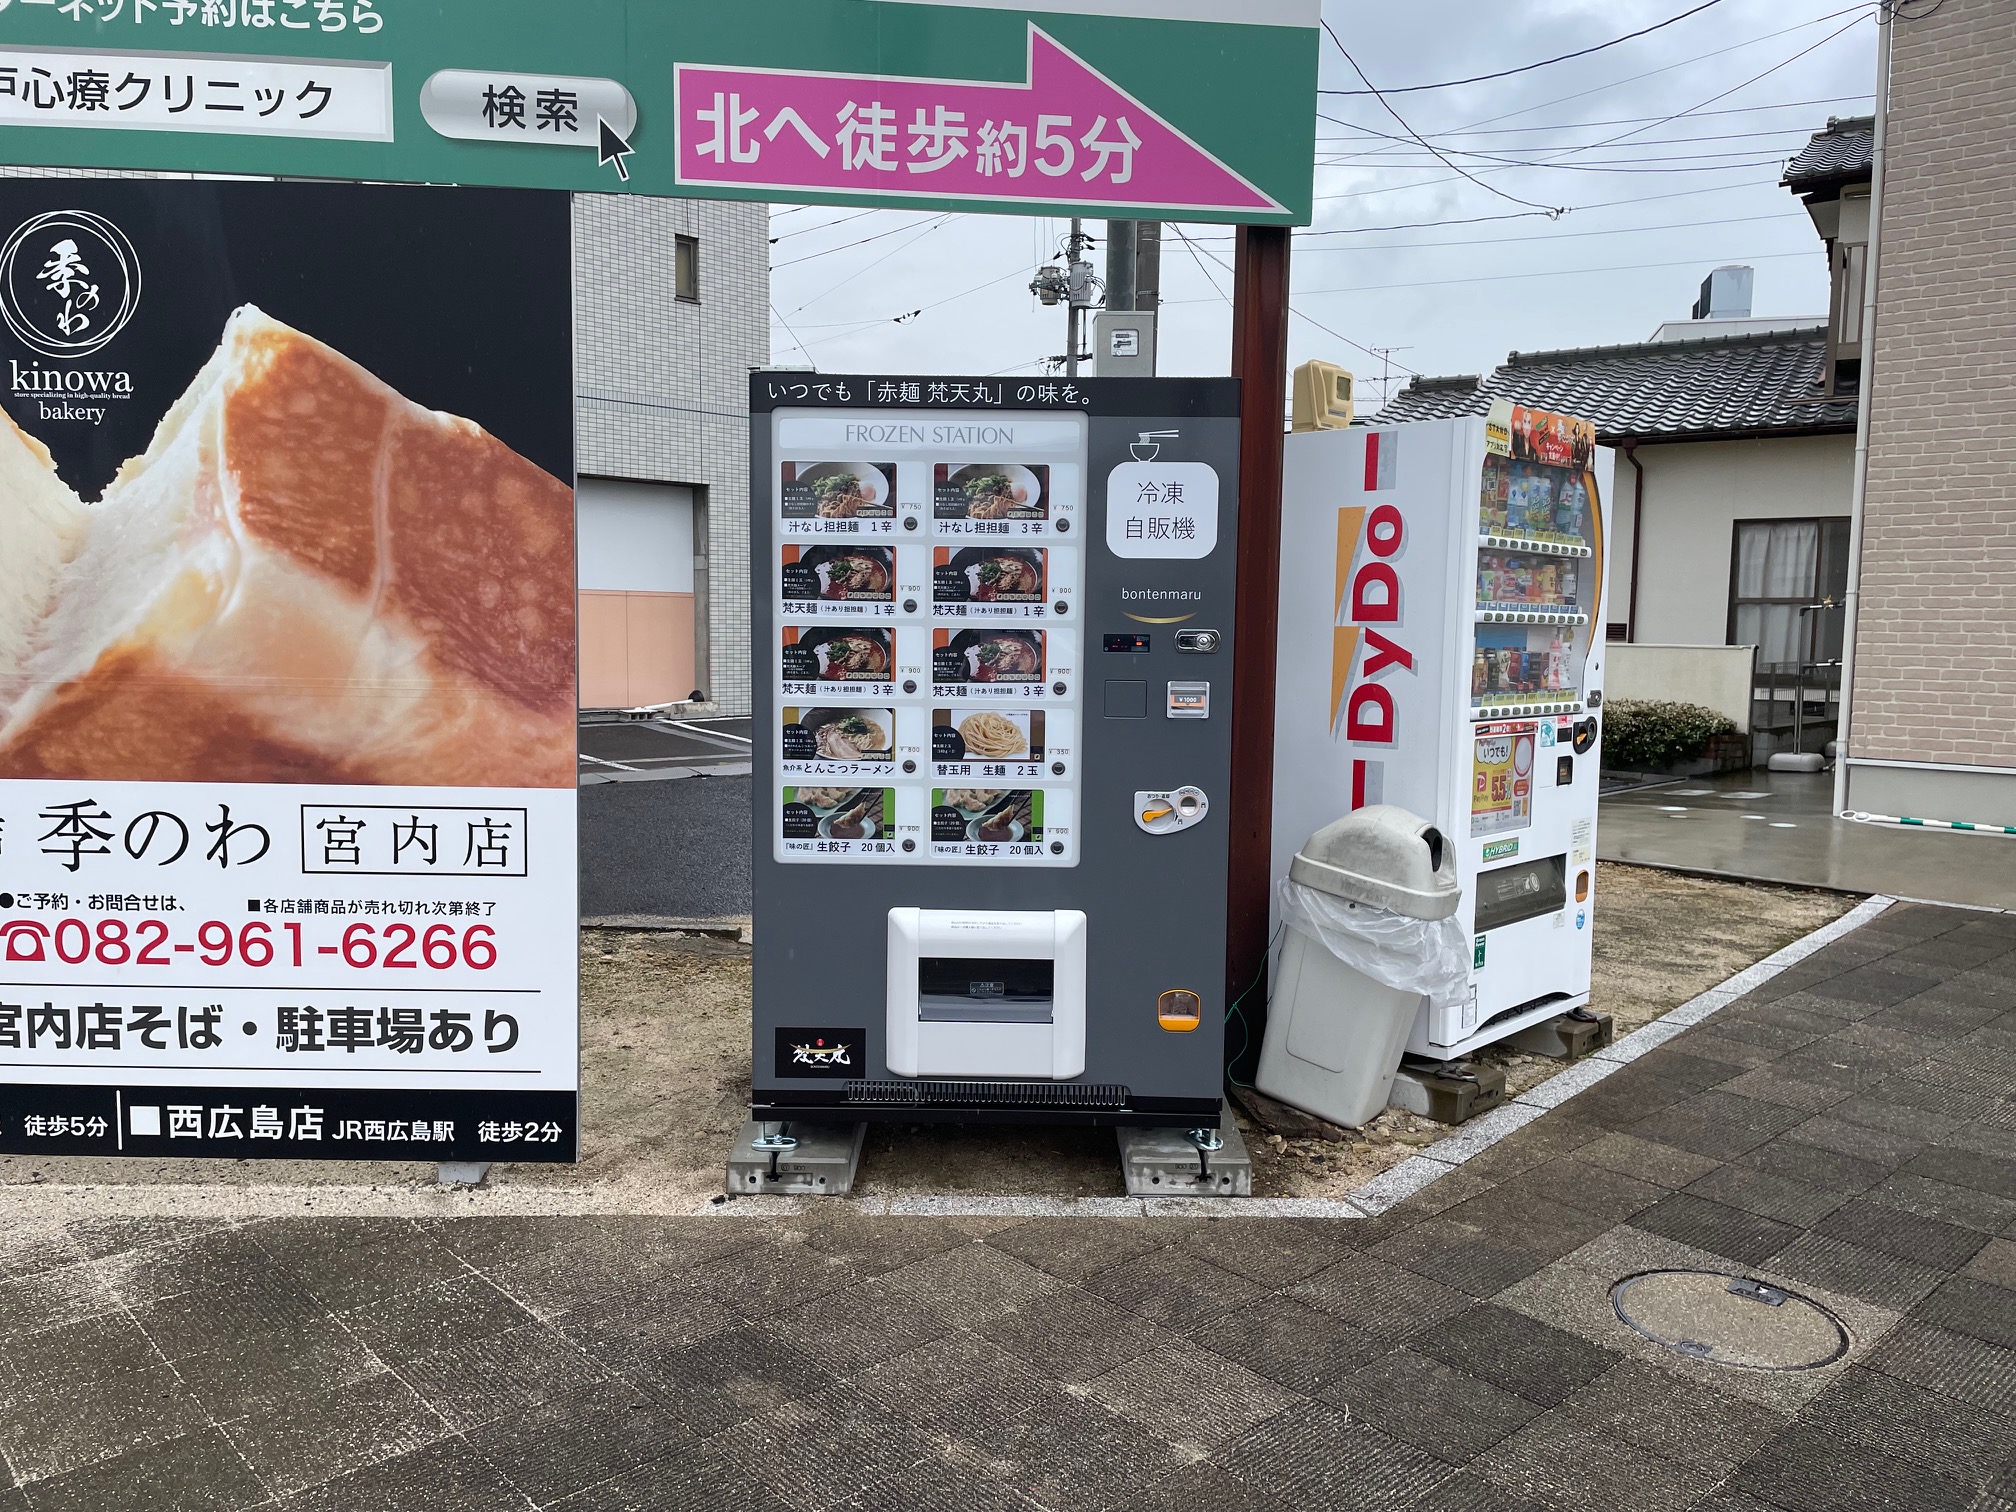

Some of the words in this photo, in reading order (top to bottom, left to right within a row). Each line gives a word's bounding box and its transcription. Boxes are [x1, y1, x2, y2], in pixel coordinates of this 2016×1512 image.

[0, 0, 383, 34] ーネット予約はこちら
[481, 84, 579, 133] 検索
[694, 92, 1143, 185] 北へ徒歩約5分
[9, 360, 134, 393] kinowa
[38, 401, 106, 426] bakery
[845, 425, 924, 444] FROZEN
[933, 426, 1014, 445] STATION
[1136, 481, 1184, 505] 冷凍
[789, 521, 859, 532] 汁なし担担麺
[939, 522, 1009, 533] 汁なし担担麺
[1125, 516, 1196, 541] 自販機
[1121, 587, 1202, 600] bontenmaru
[1346, 504, 1413, 743] DyDo
[937, 765, 970, 776] 替玉用
[983, 765, 1005, 776] 生麺
[37, 798, 271, 872] 季のわ
[316, 814, 514, 868] 宮内店
[1490, 843, 1513, 855] HYBRID
[54, 918, 498, 971] 082-961-6266
[24, 1114, 108, 1138] 徒歩5分
[167, 1103, 324, 1141] 西広島店
[332, 1120, 455, 1144] JR西広島駅
[478, 1122, 562, 1144] 徒歩2分
